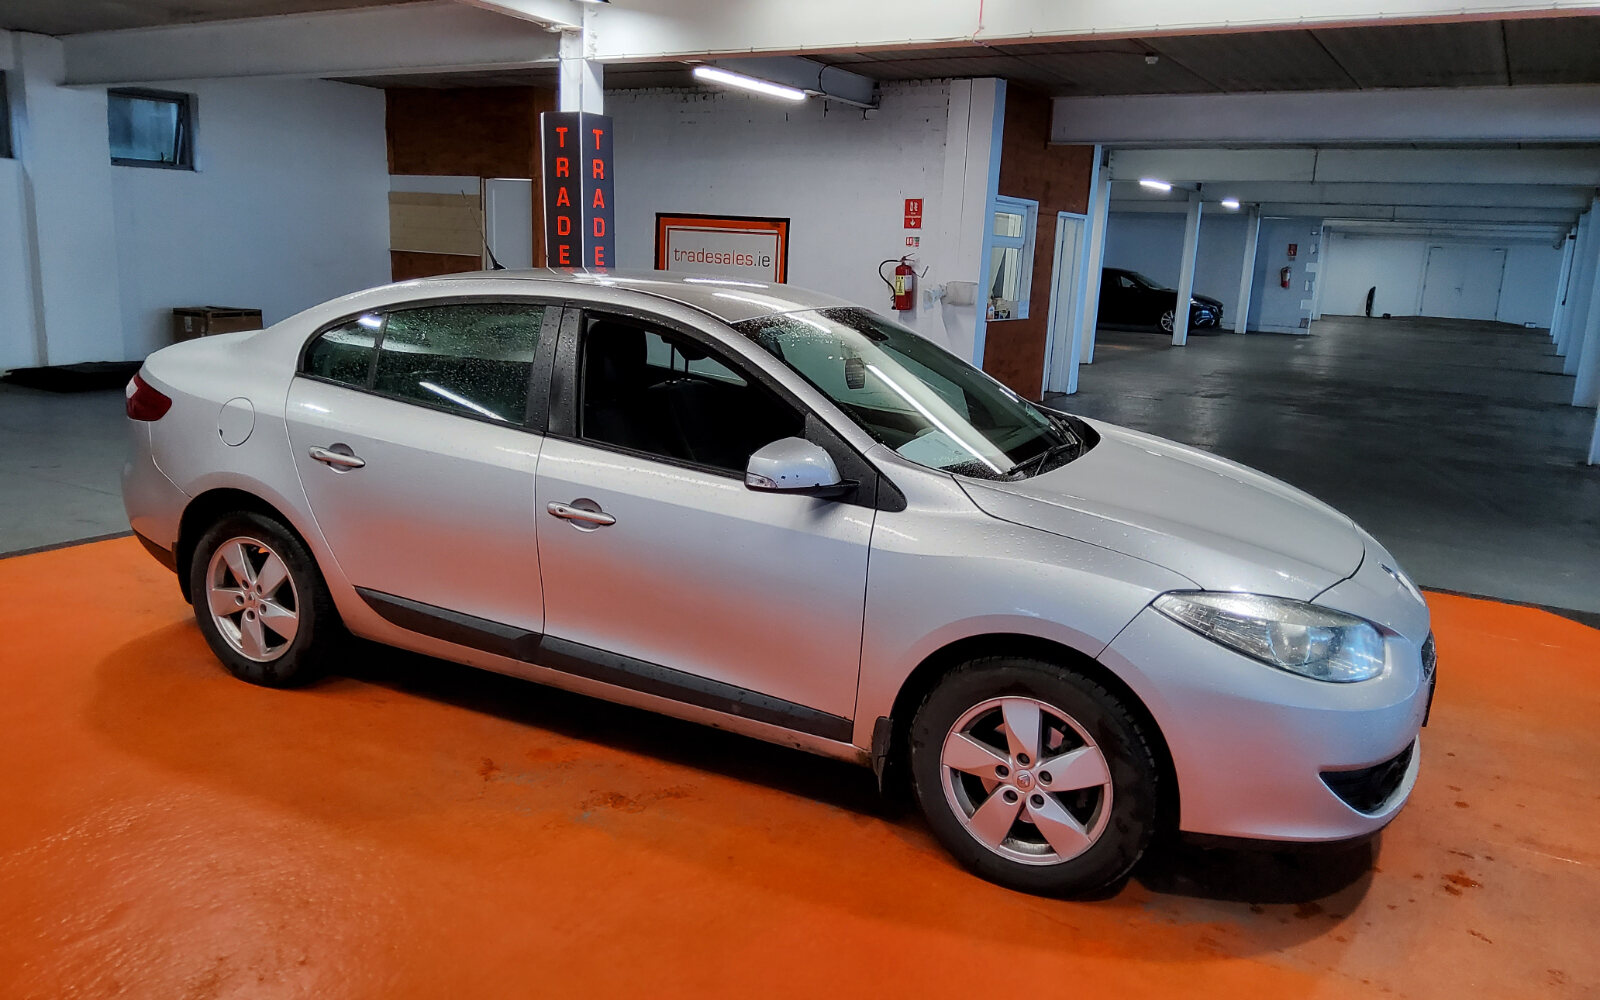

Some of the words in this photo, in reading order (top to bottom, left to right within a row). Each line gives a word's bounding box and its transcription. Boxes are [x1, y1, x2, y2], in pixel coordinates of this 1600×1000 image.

[556, 127, 571, 264] TRADE
[592, 128, 606, 266] TRADE
[673, 247, 771, 268] tradesales.ie
